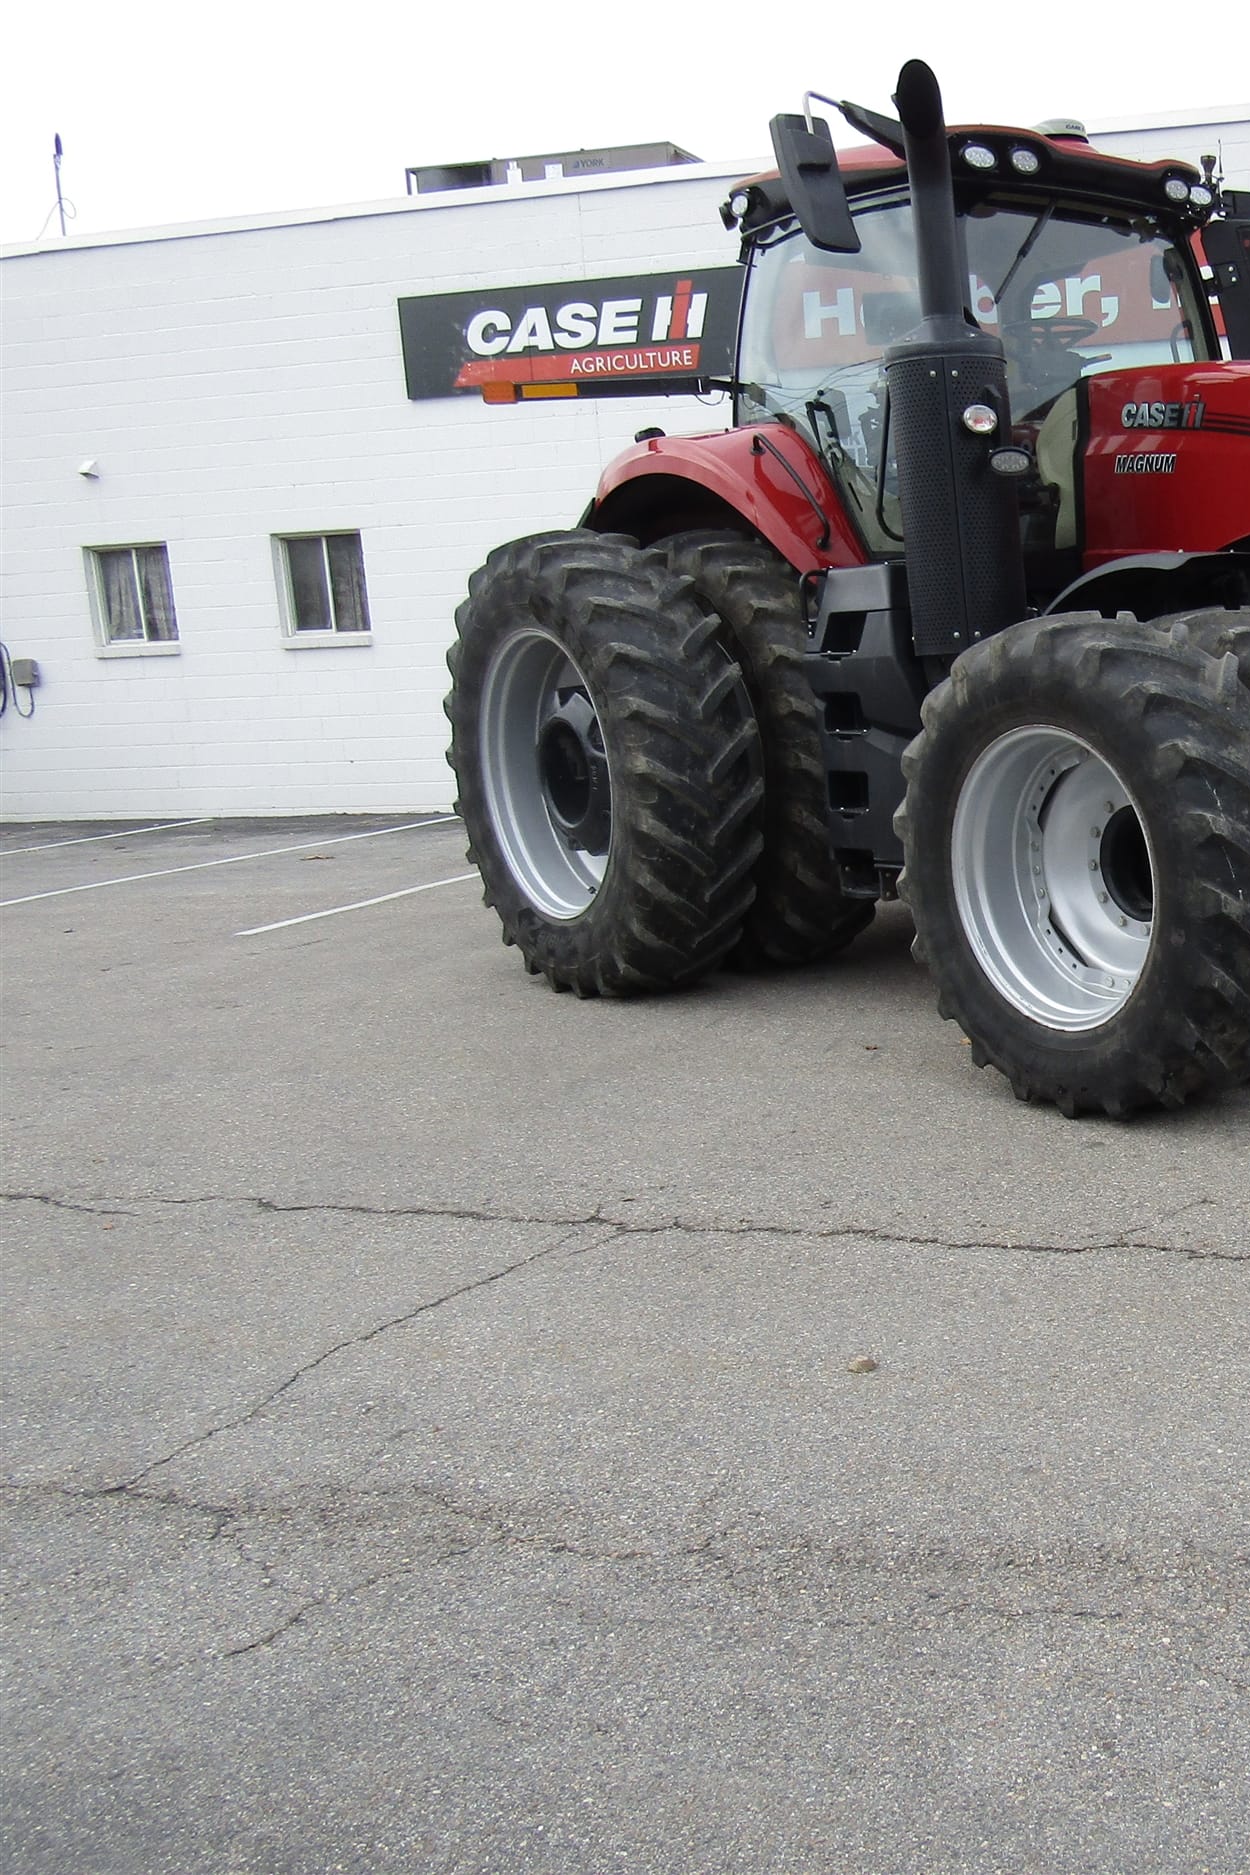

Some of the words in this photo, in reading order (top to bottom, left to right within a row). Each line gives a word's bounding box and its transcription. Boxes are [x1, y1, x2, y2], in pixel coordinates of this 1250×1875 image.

[803, 275, 1119, 339] Hber,
[467, 299, 642, 356] CASE
[571, 350, 693, 374] AGRICULTURE
[1121, 401, 1180, 428] CASE
[1114, 454, 1177, 473] MAGNUM
